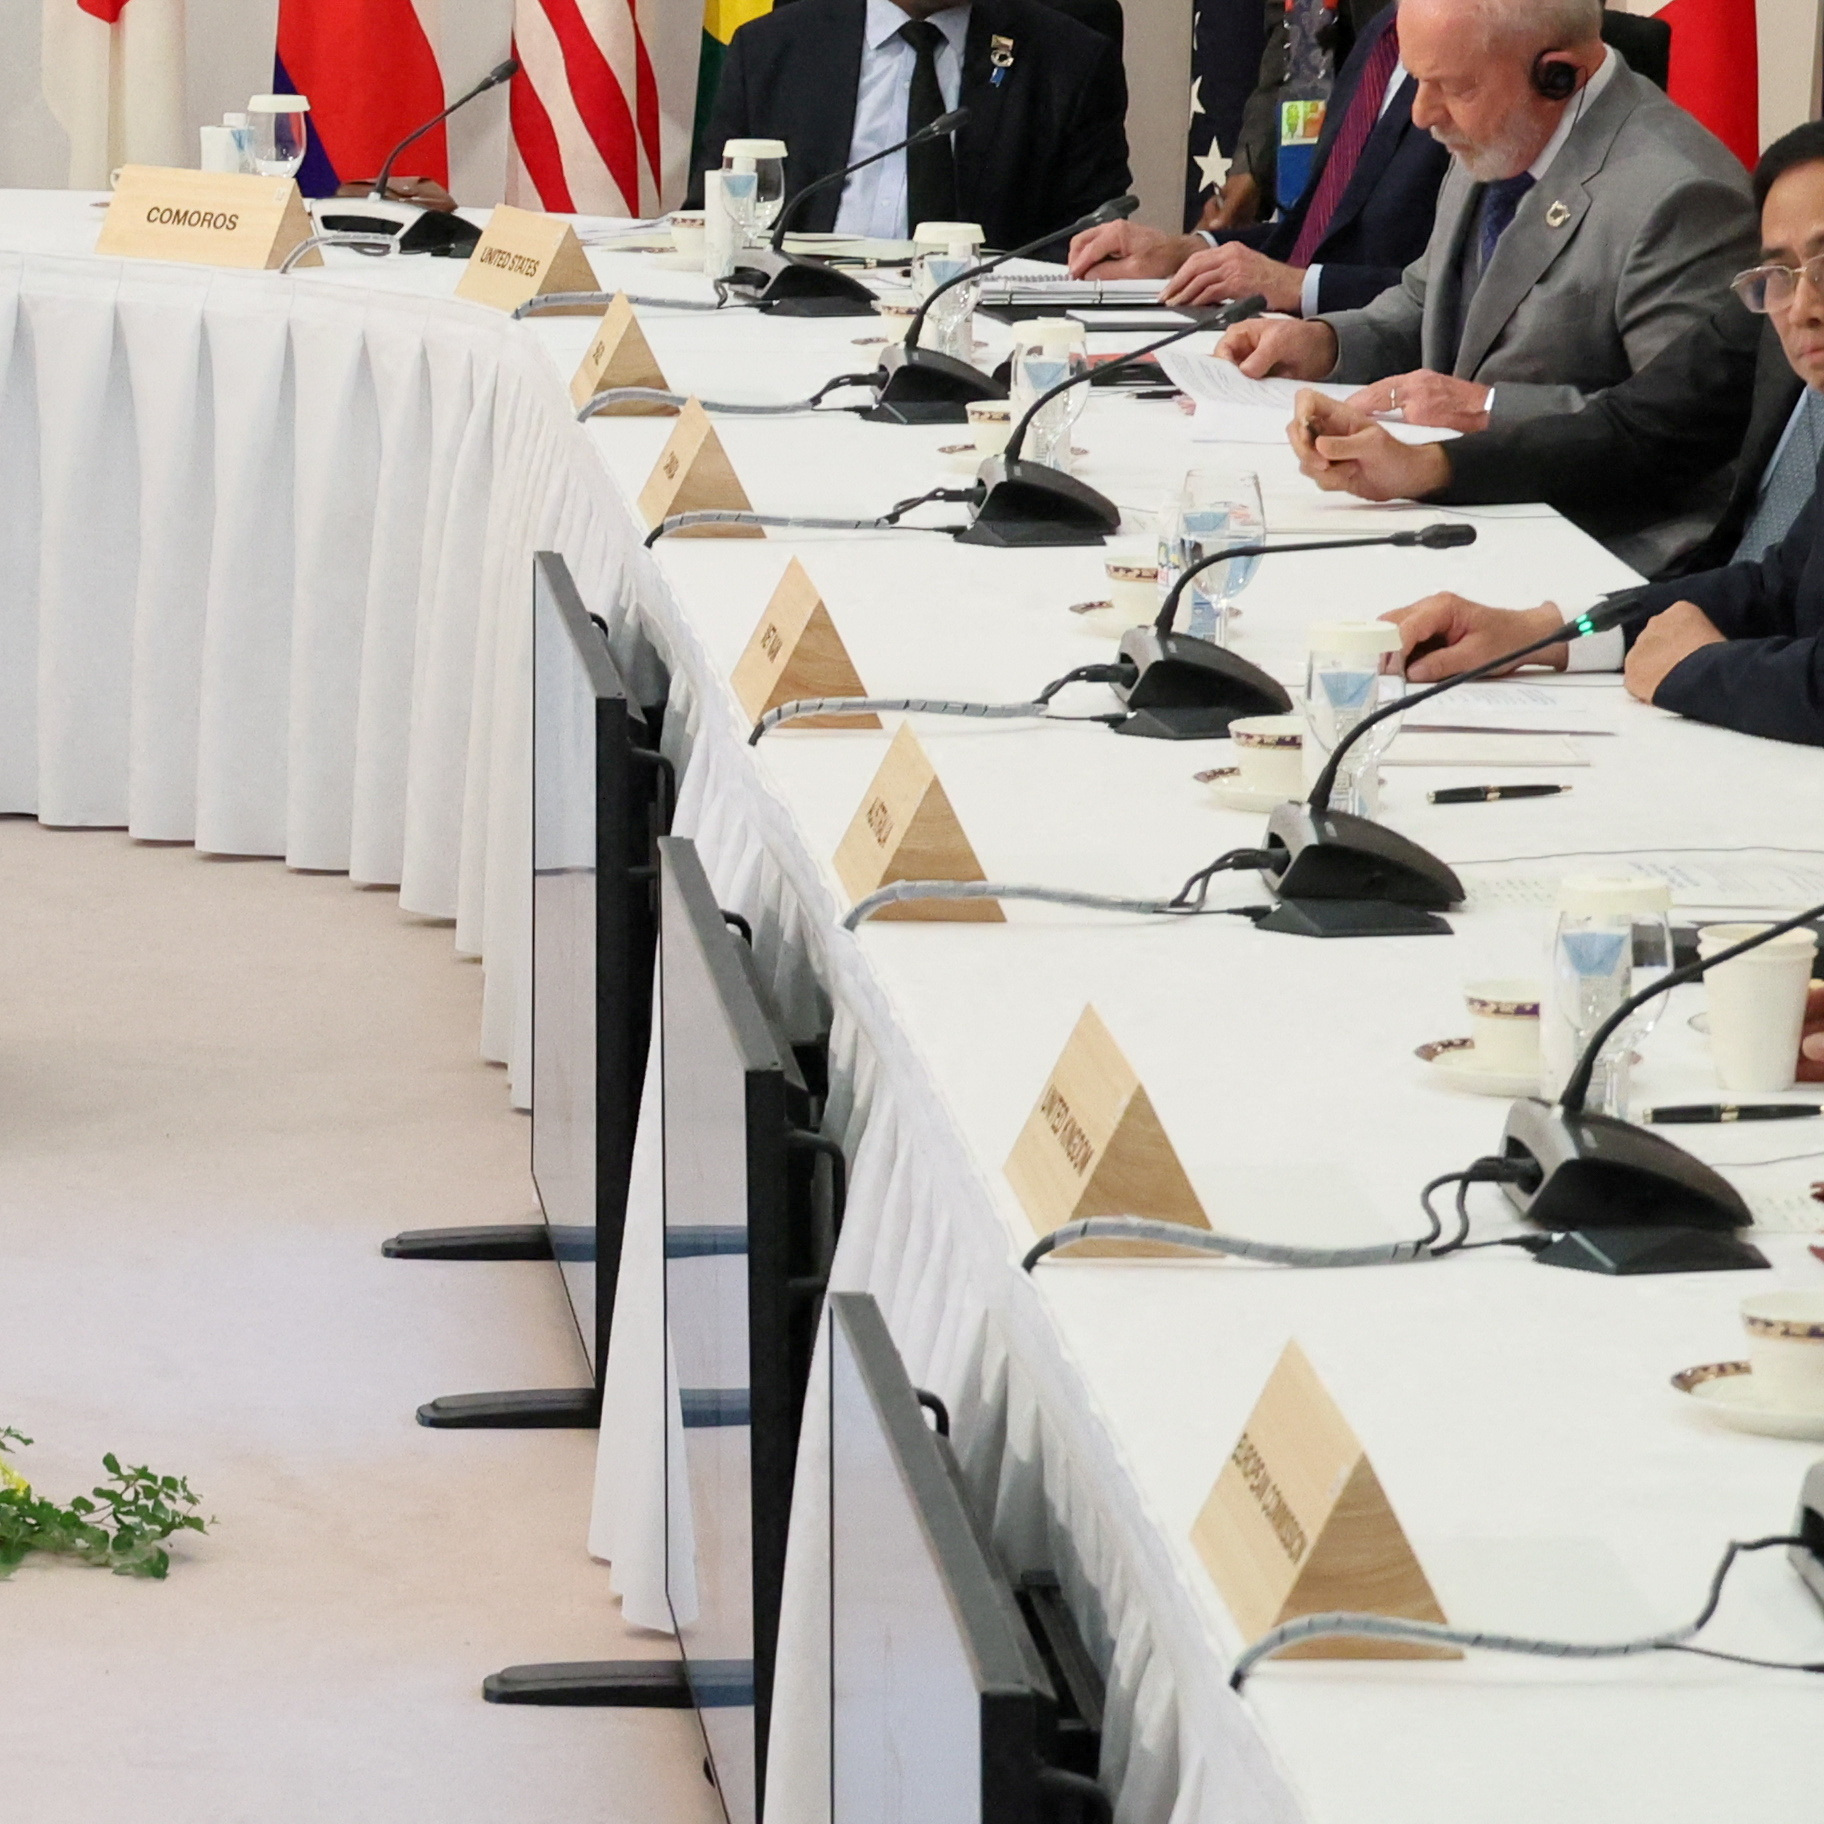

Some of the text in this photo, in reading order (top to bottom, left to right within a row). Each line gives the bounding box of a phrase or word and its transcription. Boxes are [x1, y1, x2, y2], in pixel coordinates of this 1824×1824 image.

[146, 205, 240, 231] COMOROS
[479, 245, 541, 278] UNITED STATES
